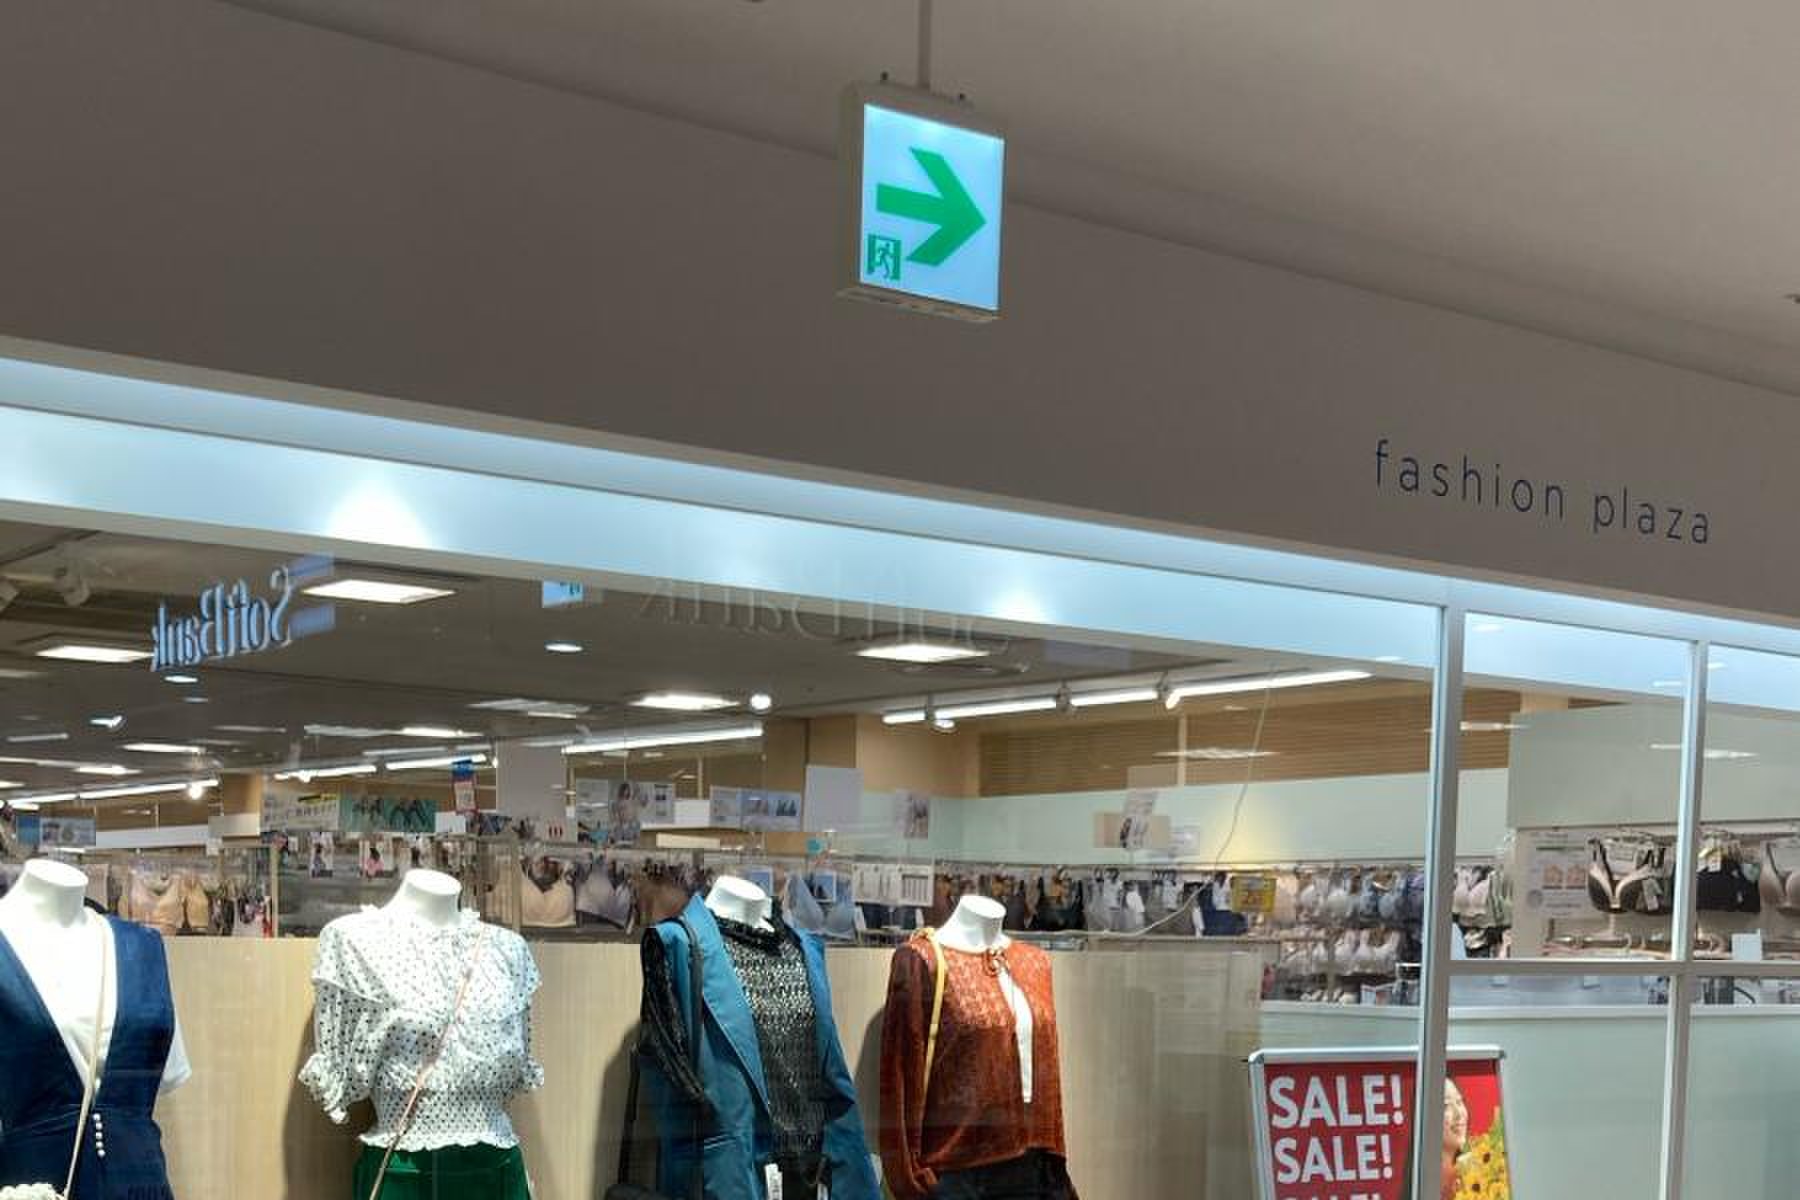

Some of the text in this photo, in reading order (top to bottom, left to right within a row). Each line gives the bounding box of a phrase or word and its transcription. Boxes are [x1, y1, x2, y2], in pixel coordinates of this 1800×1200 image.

[1376, 439, 1710, 545] fashion plaza
[1269, 1074, 1404, 1129] SALE!
[1274, 1134, 1393, 1184] SALE!
